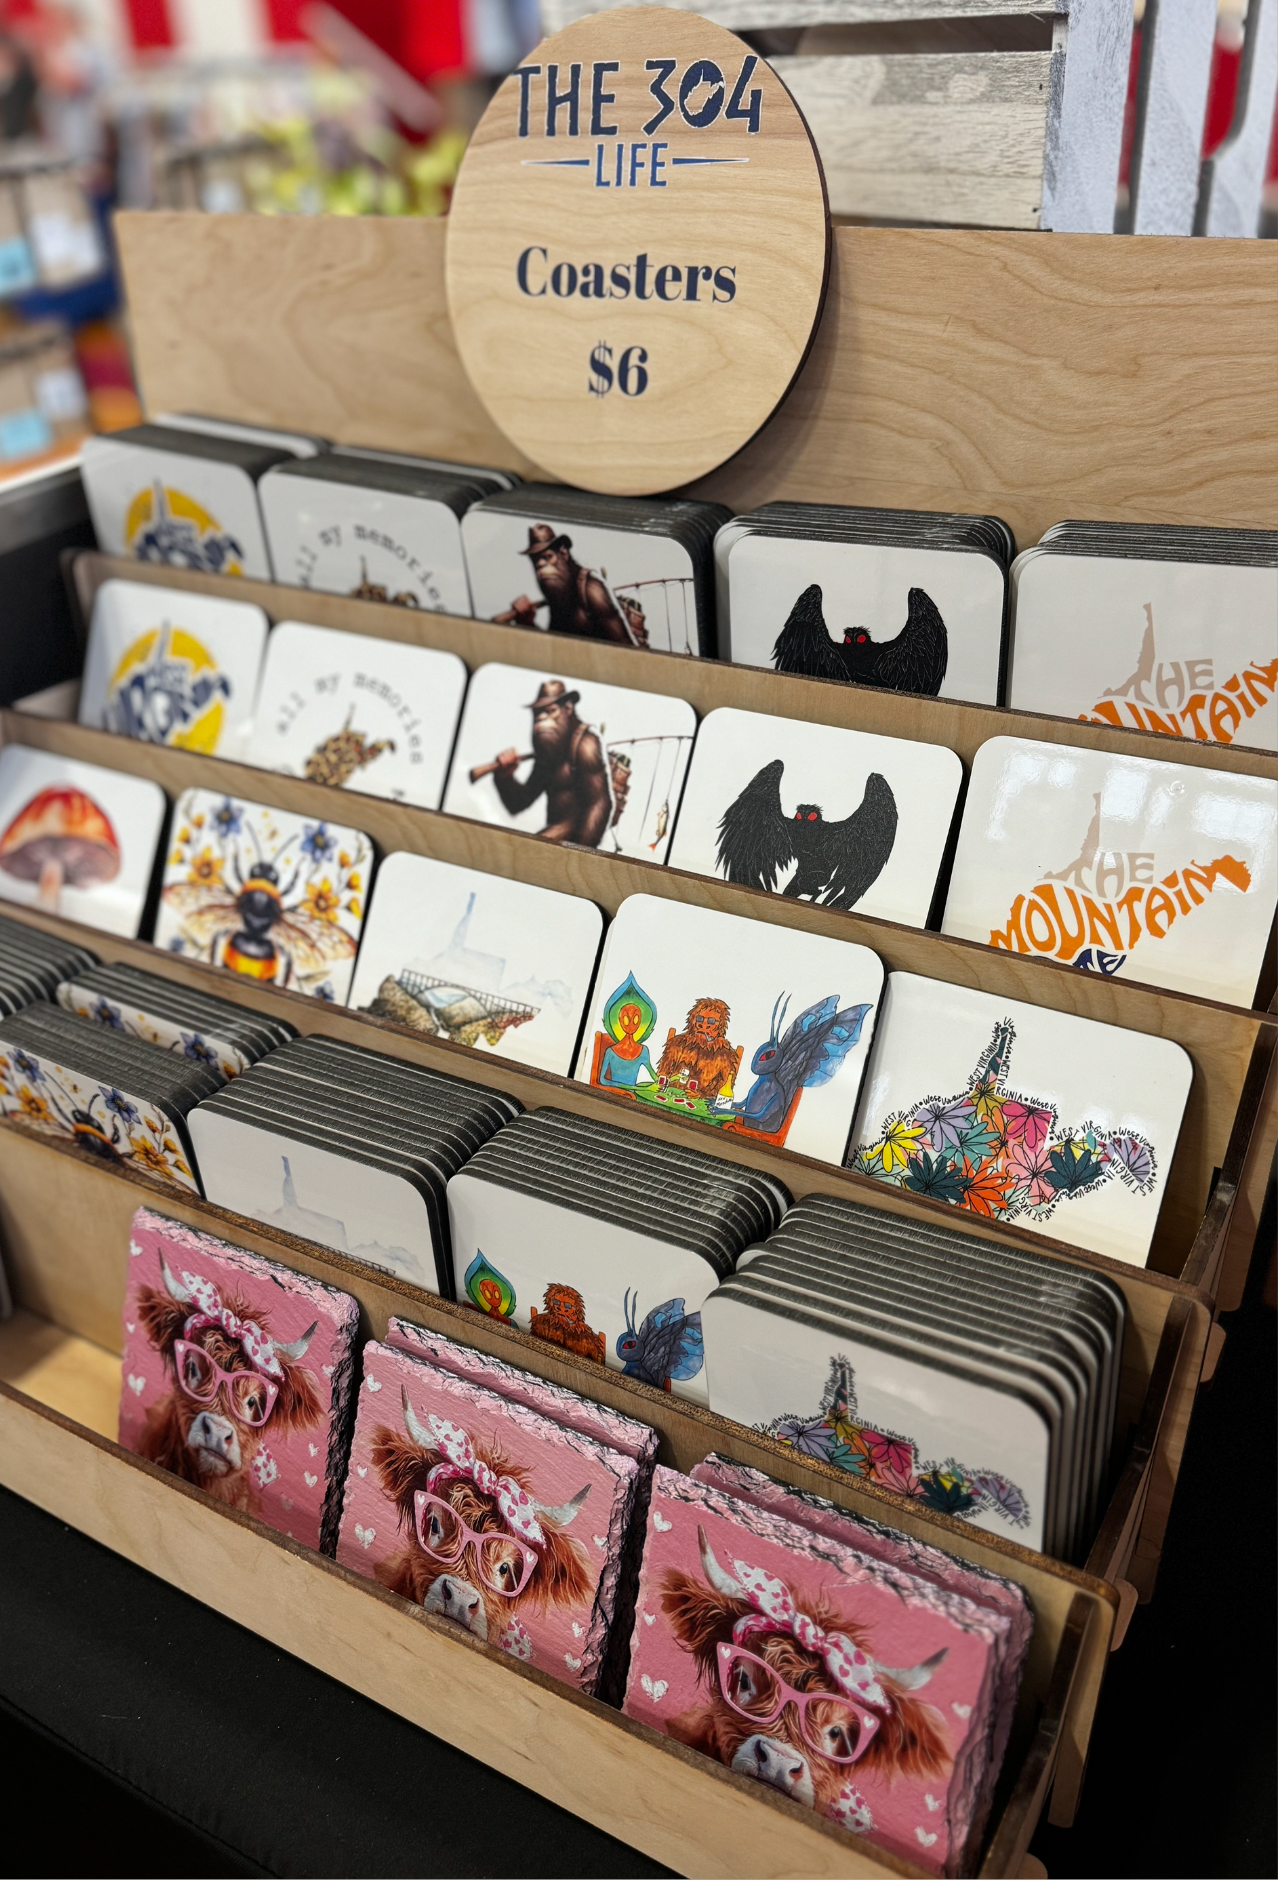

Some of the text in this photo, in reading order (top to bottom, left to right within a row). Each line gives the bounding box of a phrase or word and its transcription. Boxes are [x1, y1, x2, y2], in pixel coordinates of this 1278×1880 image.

[510, 54, 763, 138] THE 304
[595, 142, 668, 188] LIFE
[516, 246, 737, 303] Coasters
[588, 339, 648, 399] $6
[977, 1042, 999, 1070] VIRGINIA
[966, 1067, 983, 1087] WEST
[1000, 1059, 1011, 1078] WEST
[1030, 1097, 1049, 1109] West
[881, 1112, 896, 1130] WEST
[898, 1103, 921, 1127] VIRGINIA
[1055, 1127, 1079, 1141] WEST
[1081, 1120, 1112, 1141] VIRGINIA
[1119, 1127, 1139, 1139] West
[858, 1136, 885, 1152] Virginia
[1104, 1158, 1135, 1187] VIRGINIA
[1131, 1176, 1157, 1197] WEST
[1009, 1197, 1032, 1220] VIRGINIA
[1032, 1207, 1055, 1222] WEST
